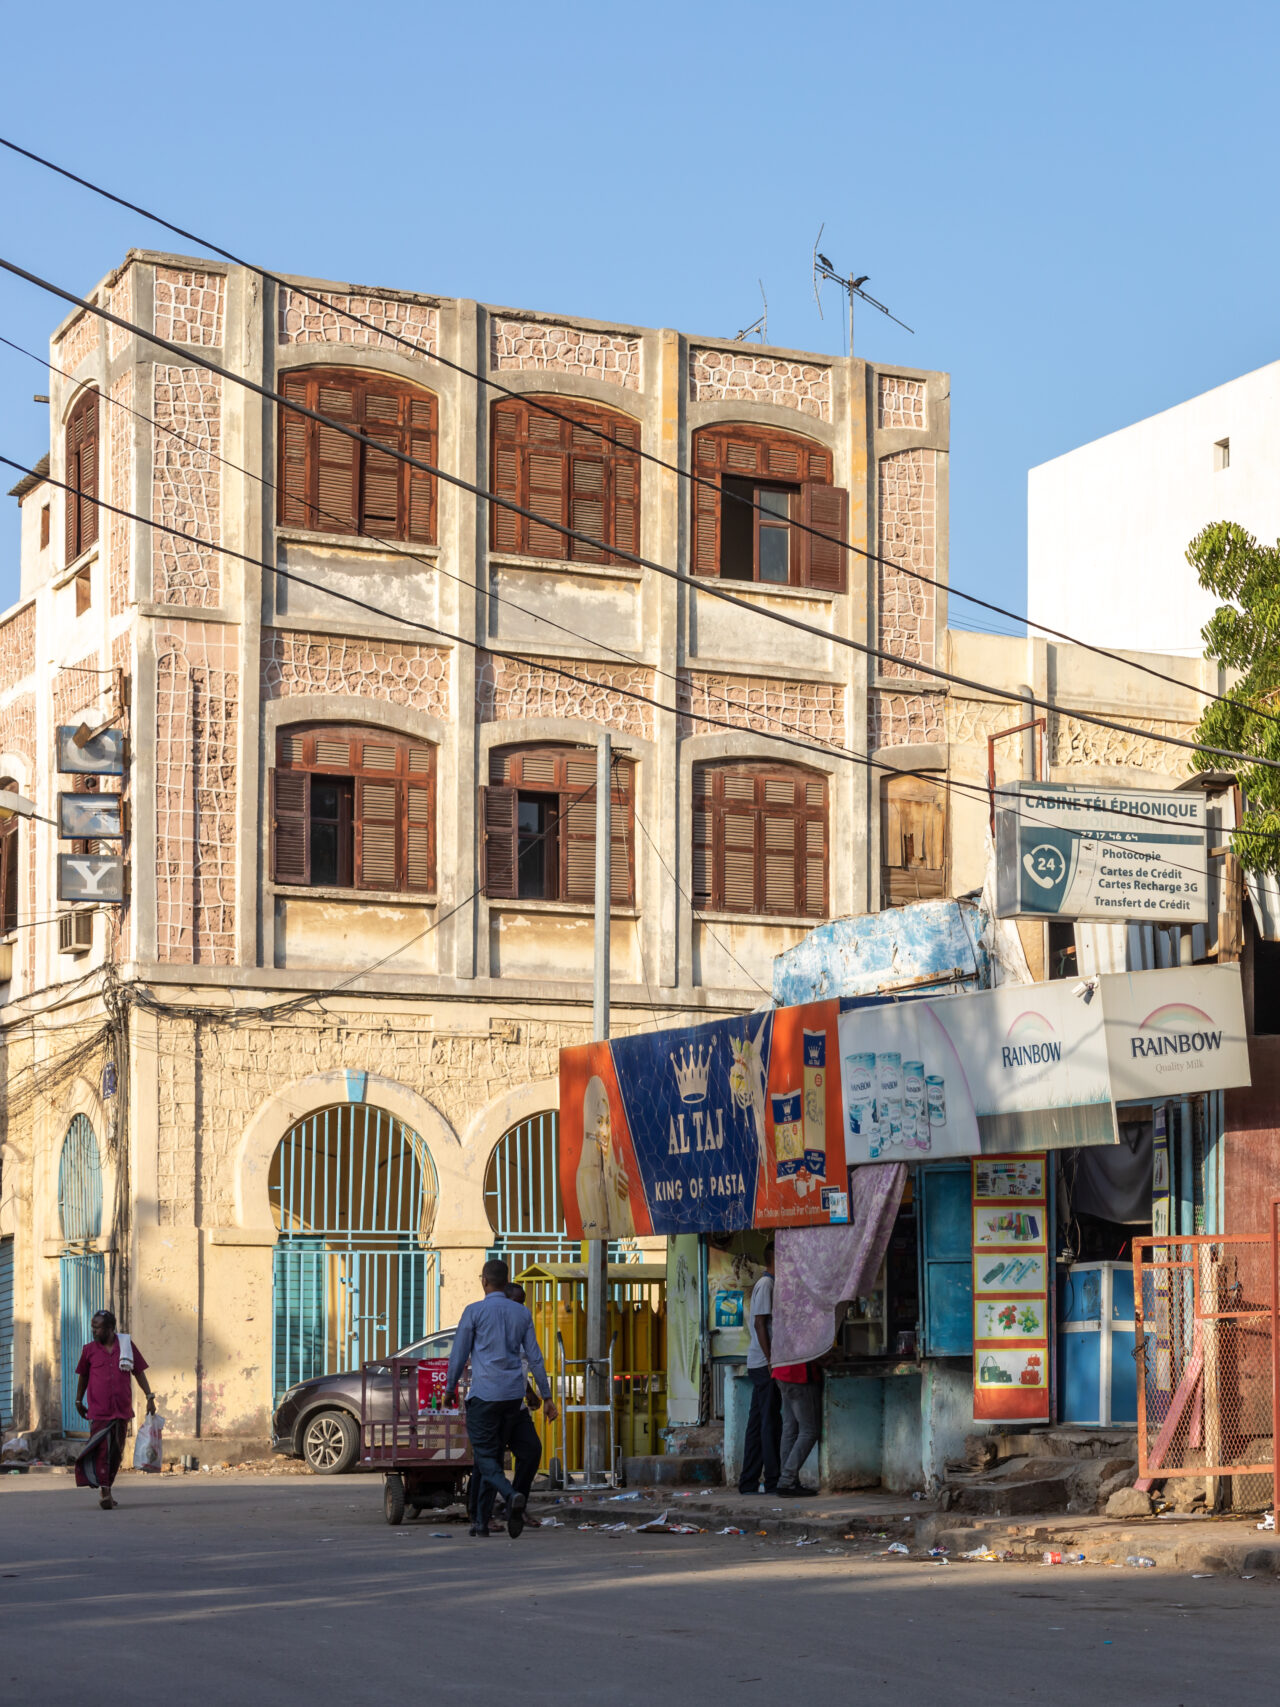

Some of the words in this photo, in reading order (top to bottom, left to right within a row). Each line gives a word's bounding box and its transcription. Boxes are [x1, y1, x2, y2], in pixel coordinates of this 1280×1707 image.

[1025, 796, 1081, 812] CABINE
[1084, 796, 1198, 818] TÉLÉPHONIQUE
[1037, 857, 1056, 871] 24
[1102, 848, 1161, 862] Photocopie
[66, 860, 118, 895] Y
[1100, 866, 1134, 878] Cartes
[1136, 867, 1149, 878] de
[1150, 868, 1182, 879] Crédit
[1098, 879, 1132, 890] Cartes
[1133, 880, 1182, 894] Recharge
[1183, 882, 1198, 893] 3G
[1094, 896, 1142, 908] Transfert
[1143, 897, 1156, 909] de
[1158, 898, 1191, 910] Crédit
[1002, 1040, 1062, 1068] RAINBOW
[1130, 1030, 1224, 1059] RAINBOW
[1155, 1060, 1185, 1074] Quality
[1185, 1058, 1205, 1071] Milk
[668, 1113, 690, 1155] AL
[692, 1108, 724, 1152] TAJ
[654, 1179, 683, 1201] KING
[689, 1177, 704, 1200] OF
[710, 1172, 747, 1197] PASTA
